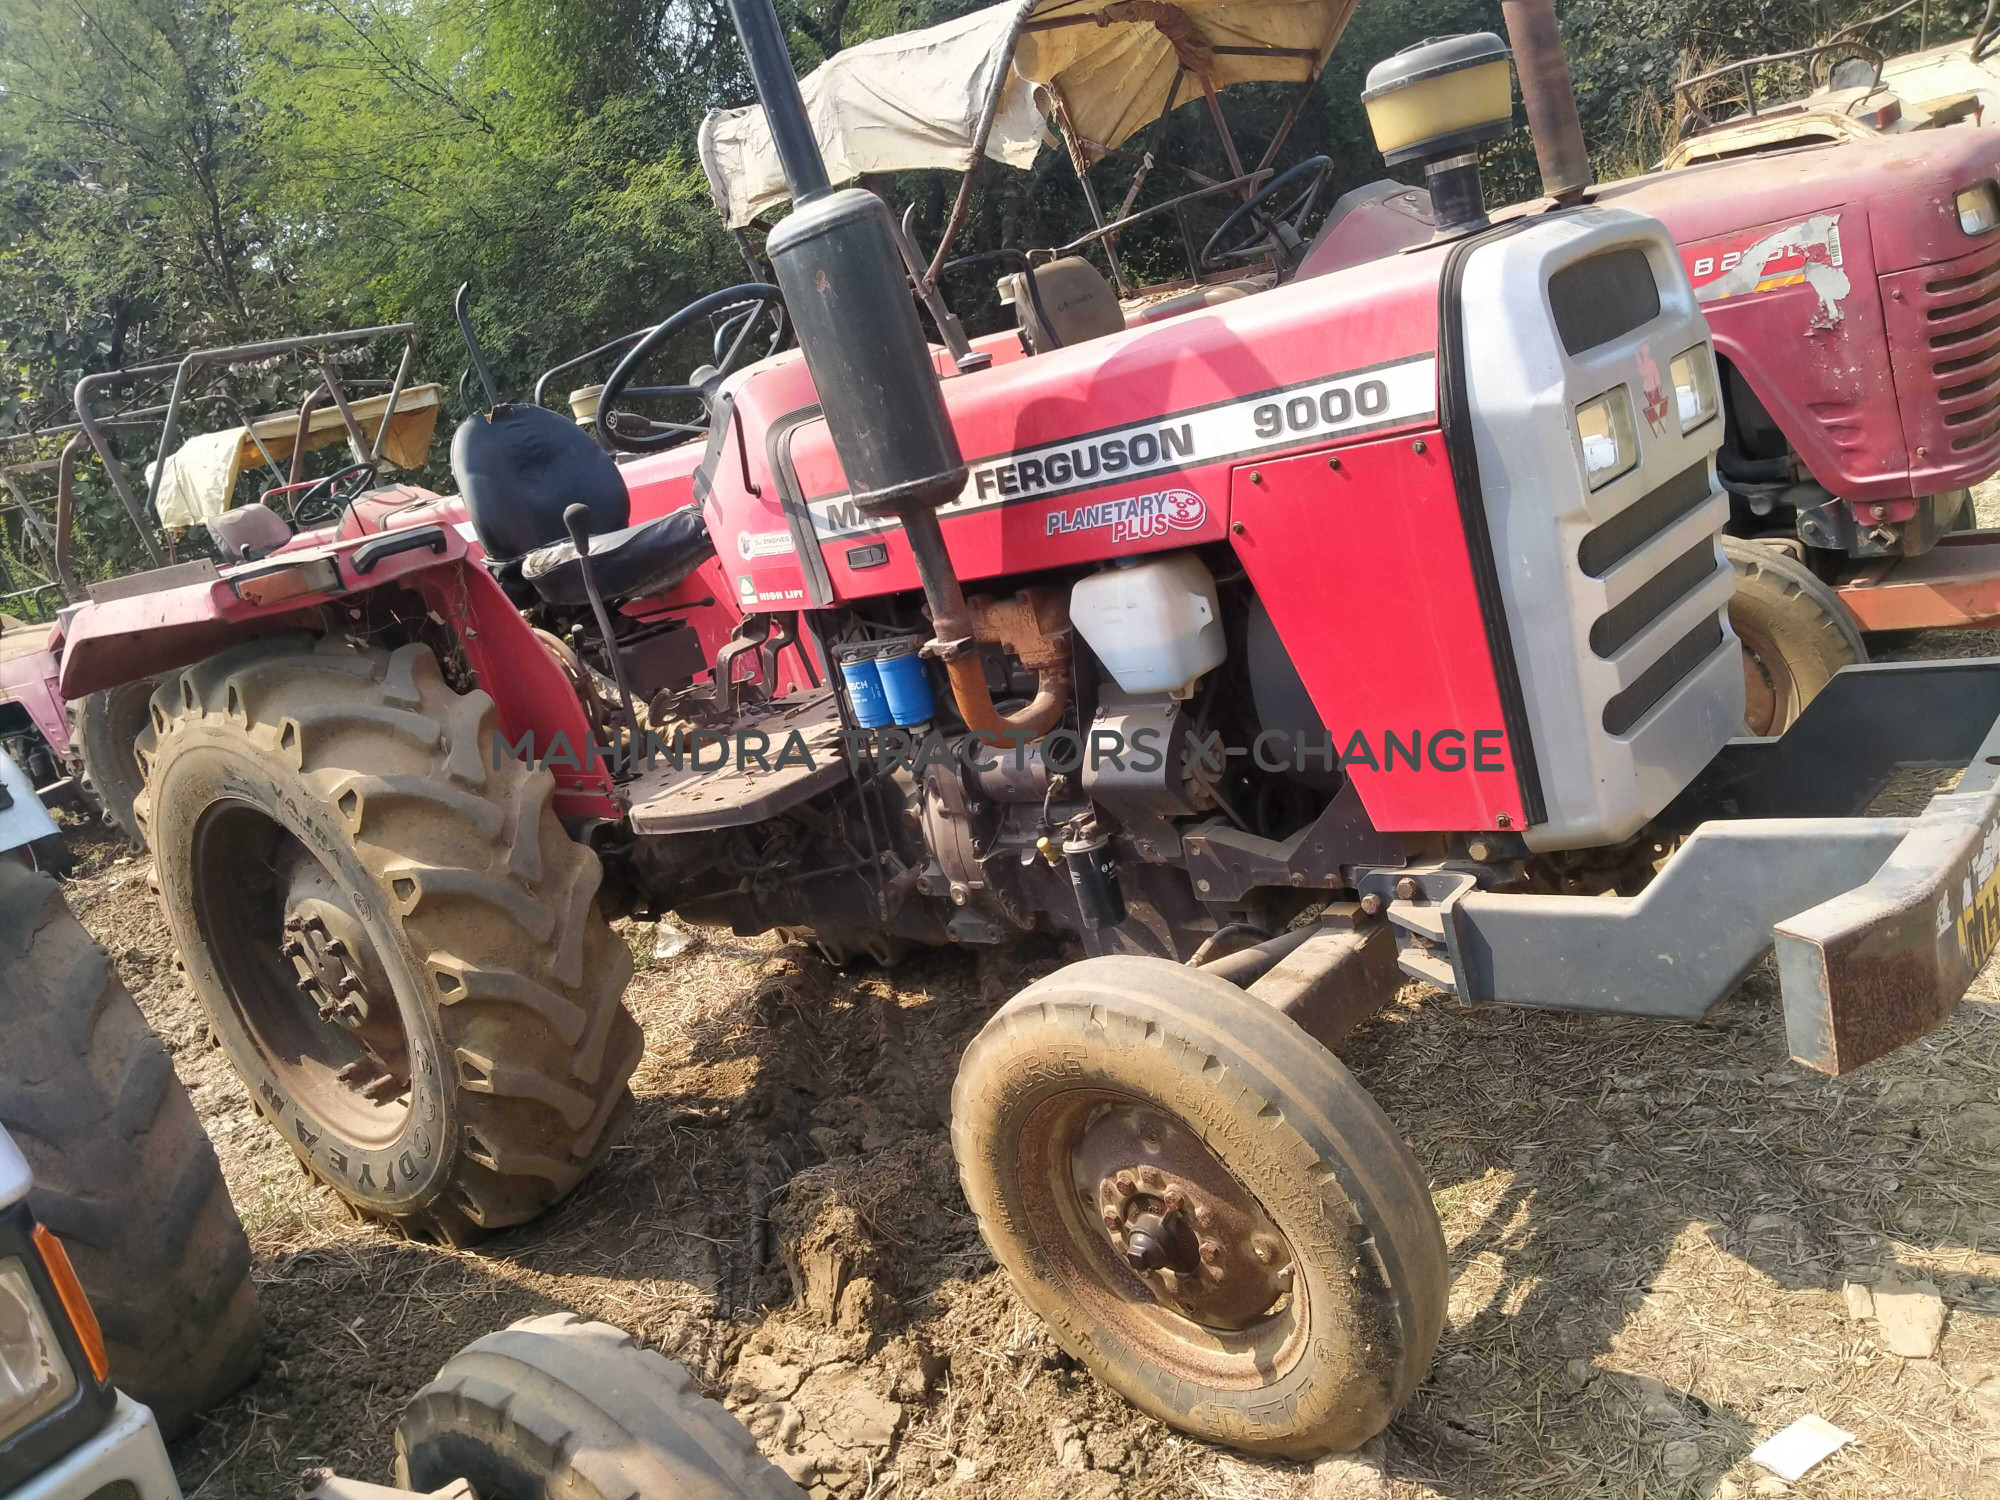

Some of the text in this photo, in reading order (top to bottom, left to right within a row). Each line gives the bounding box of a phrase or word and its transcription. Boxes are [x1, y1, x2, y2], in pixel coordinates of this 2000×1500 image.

[975, 379, 1391, 500] FERGUSON 9000
[1047, 491, 1170, 538] PLANETARY
[1112, 513, 1169, 544] PLUS
[759, 589, 804, 602] HIGH LIFT
[259, 1036, 436, 1194] GOODYEAR
